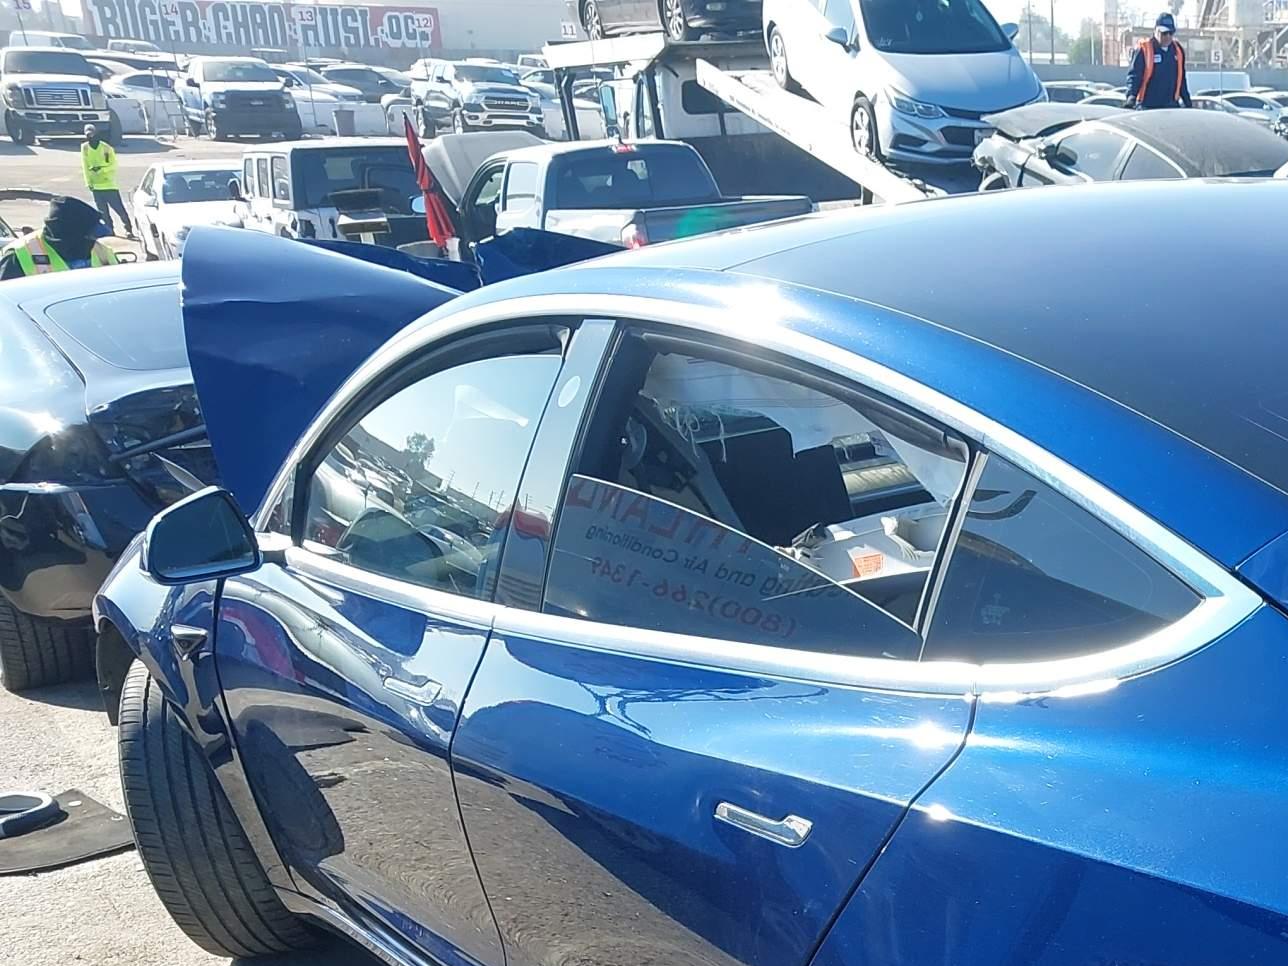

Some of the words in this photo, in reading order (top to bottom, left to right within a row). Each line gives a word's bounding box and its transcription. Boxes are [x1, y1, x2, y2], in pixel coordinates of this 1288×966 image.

[14, 0, 32, 10] 15
[163, 4, 179, 16] 14
[298, 10, 314, 22] 13
[562, 24, 577, 36] 11
